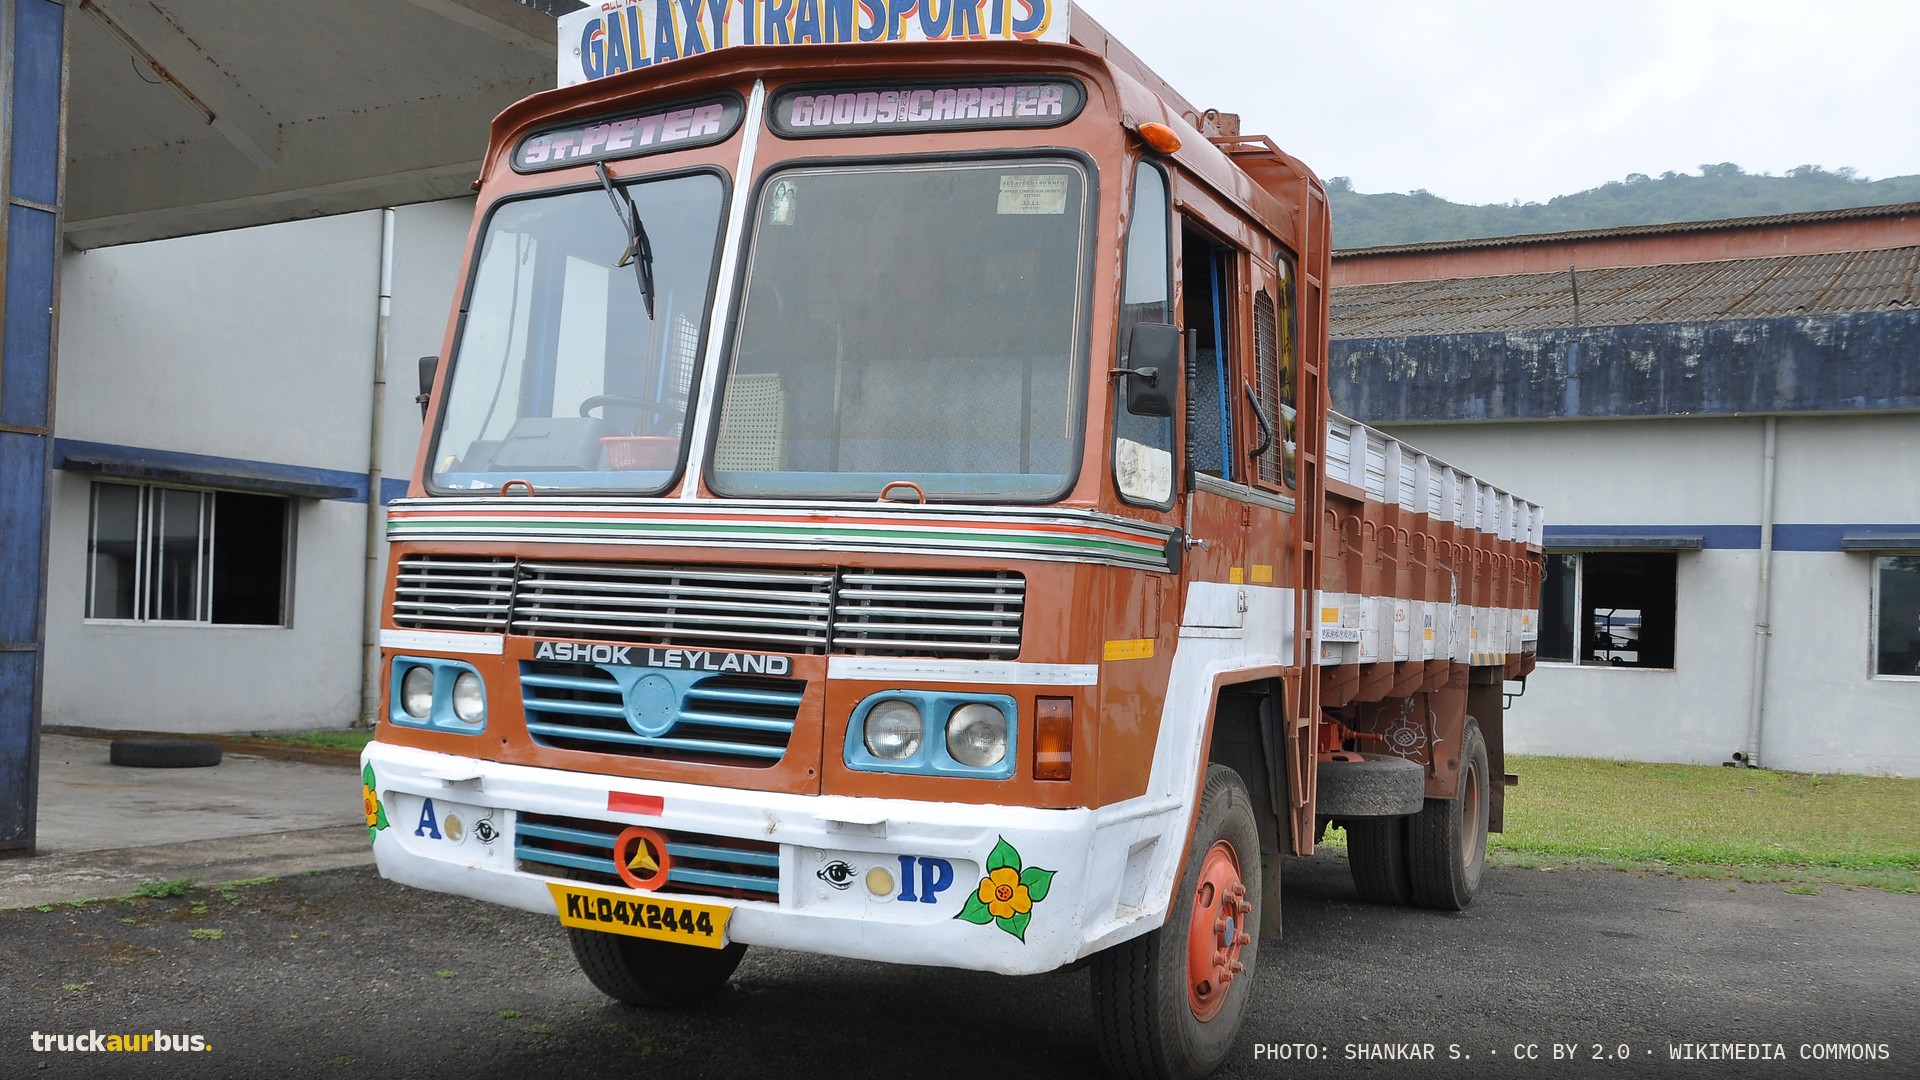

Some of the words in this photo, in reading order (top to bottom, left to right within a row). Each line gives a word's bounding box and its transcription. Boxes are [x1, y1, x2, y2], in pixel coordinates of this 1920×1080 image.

[580, 0, 733, 81] GALAXY
[790, 91, 899, 127] GOODS
[907, 86, 1063, 122] CARRIER
[534, 642, 631, 665] ASHOK
[648, 649, 789, 676] LEYLAND
[414, 797, 442, 840] A
[897, 855, 954, 904] IP
